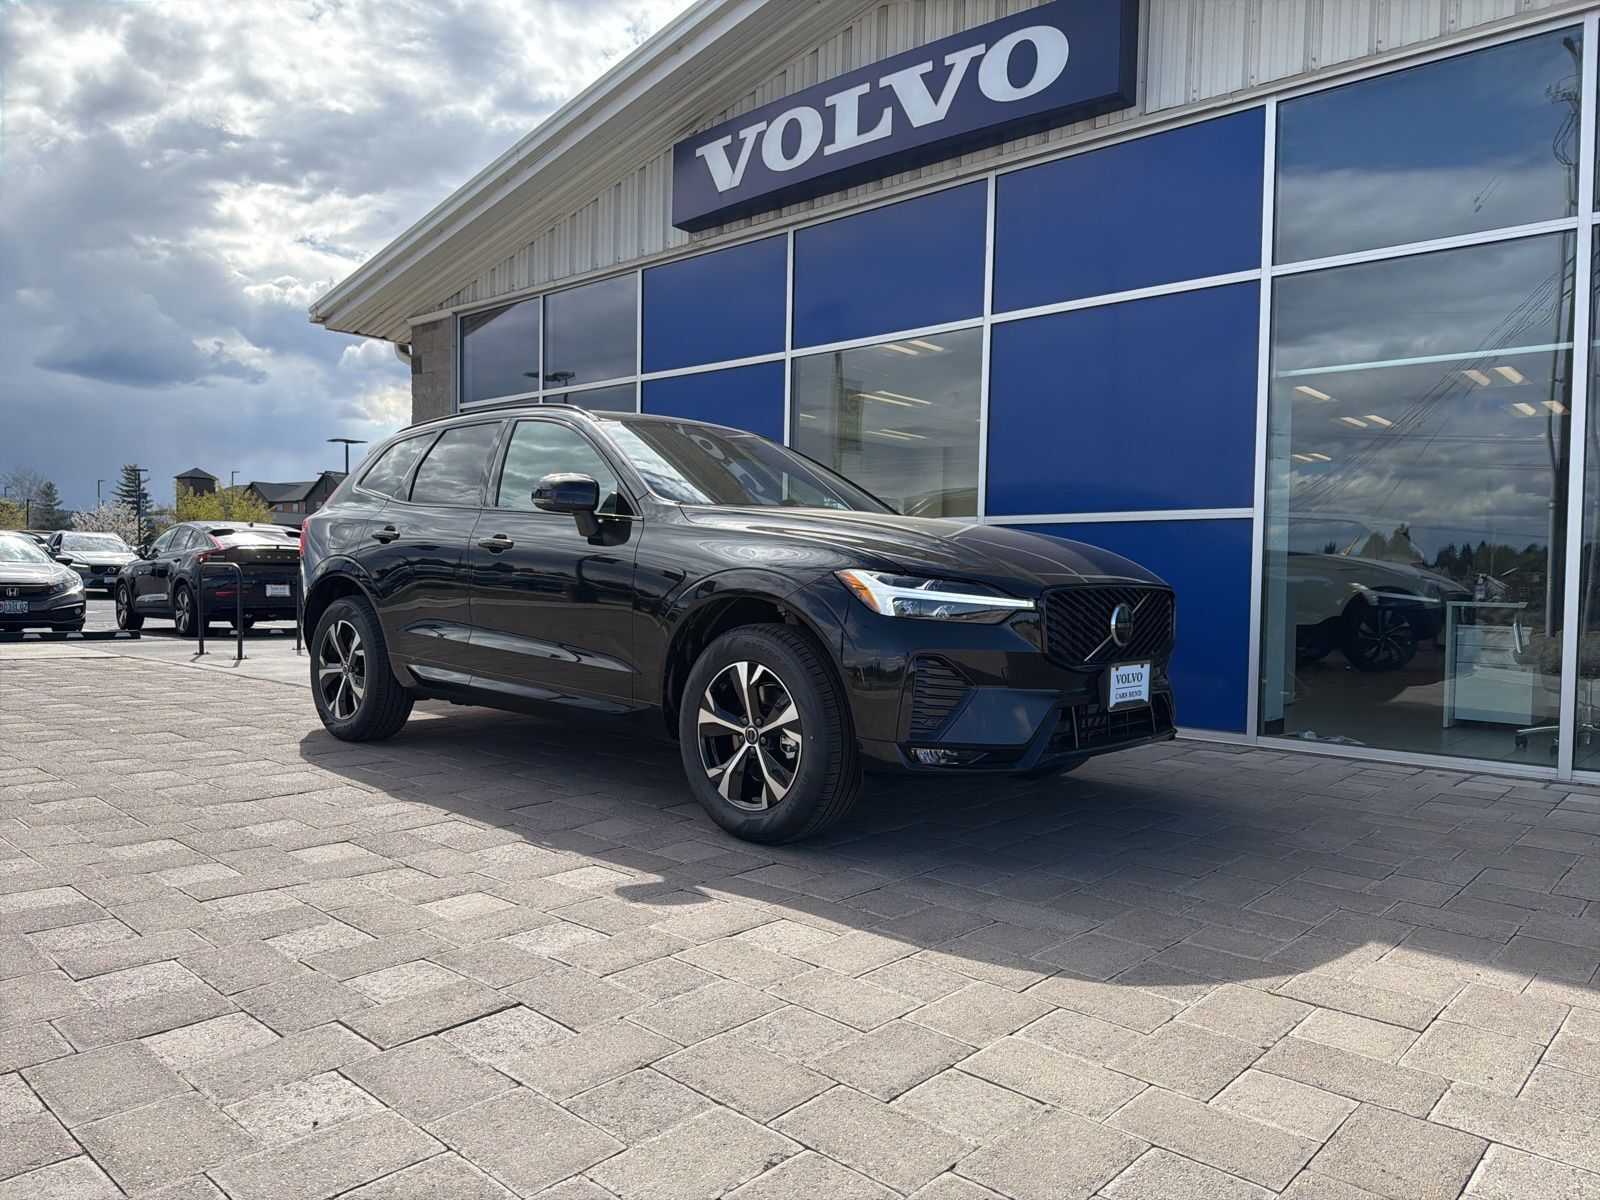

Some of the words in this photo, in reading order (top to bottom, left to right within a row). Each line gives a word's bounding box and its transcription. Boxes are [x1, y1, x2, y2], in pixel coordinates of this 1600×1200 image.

[695, 25, 1070, 193] VOLVO
[1116, 672, 1143, 684] VOLVO
[1116, 691, 1128, 699] CARS
[1129, 690, 1142, 698] BEND
